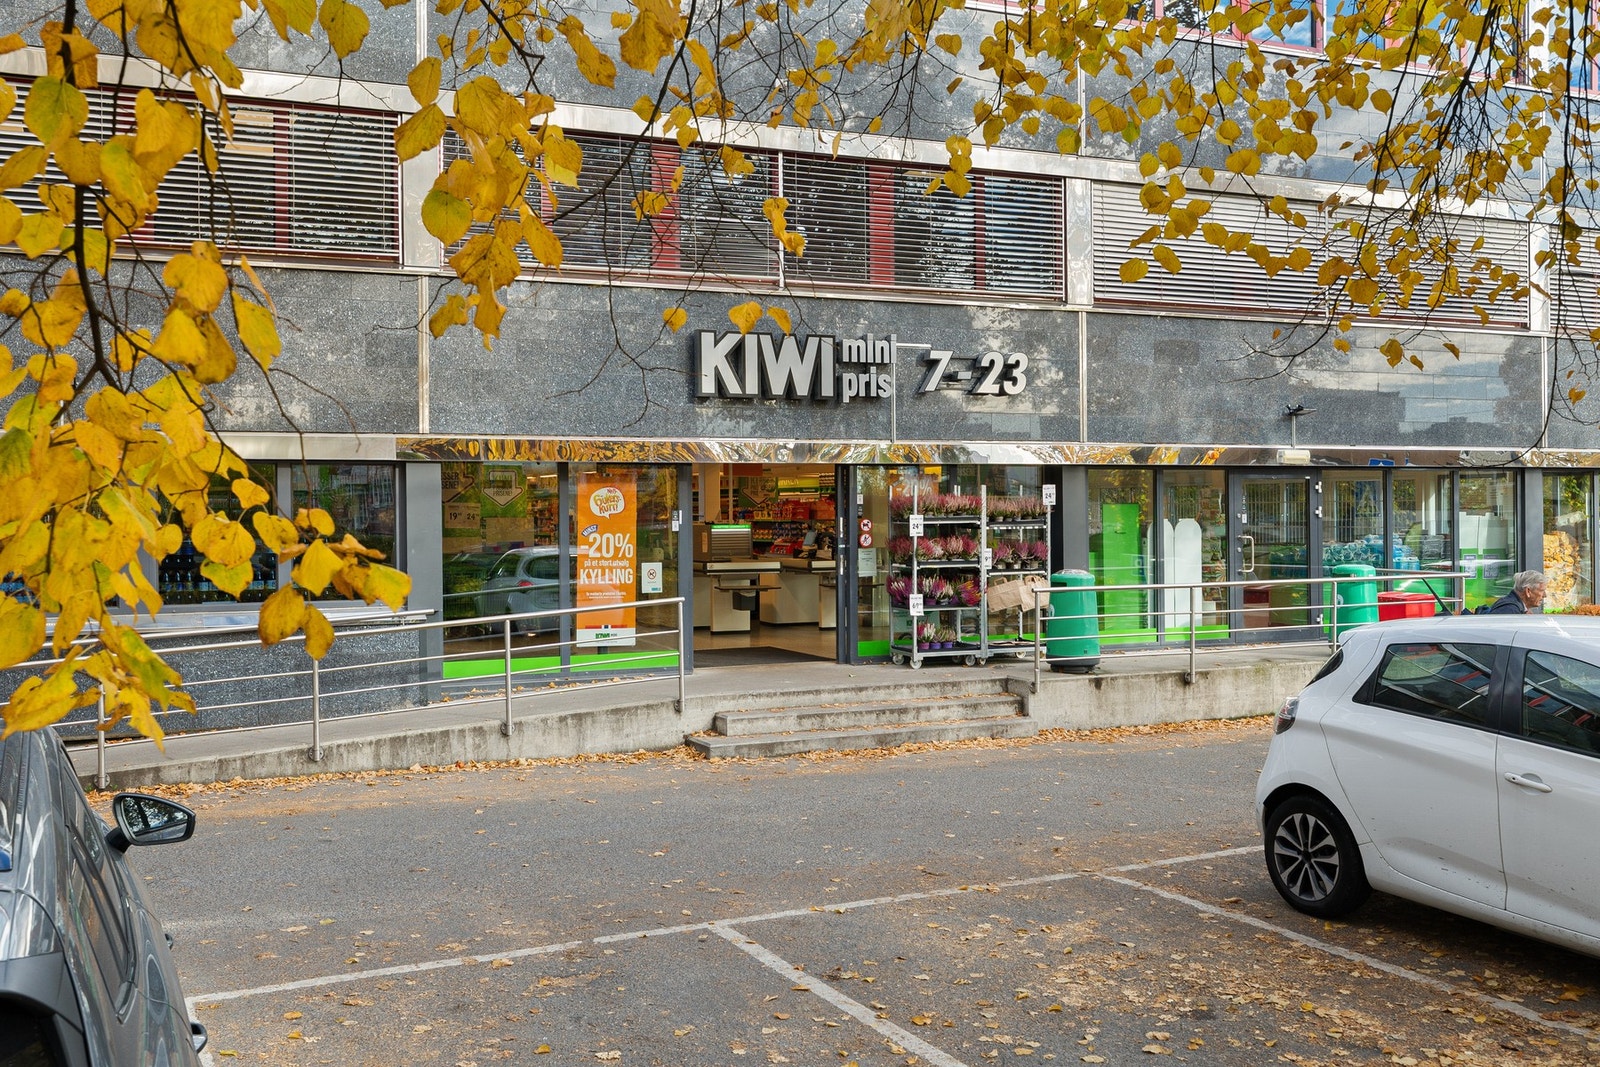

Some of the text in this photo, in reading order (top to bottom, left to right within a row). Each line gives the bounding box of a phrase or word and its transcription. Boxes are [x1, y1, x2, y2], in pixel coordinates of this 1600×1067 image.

[699, 331, 897, 397] KIWI mini
[842, 366, 892, 402] pris
[580, 533, 634, 558] -20%
[580, 568, 634, 585] KYLLING
